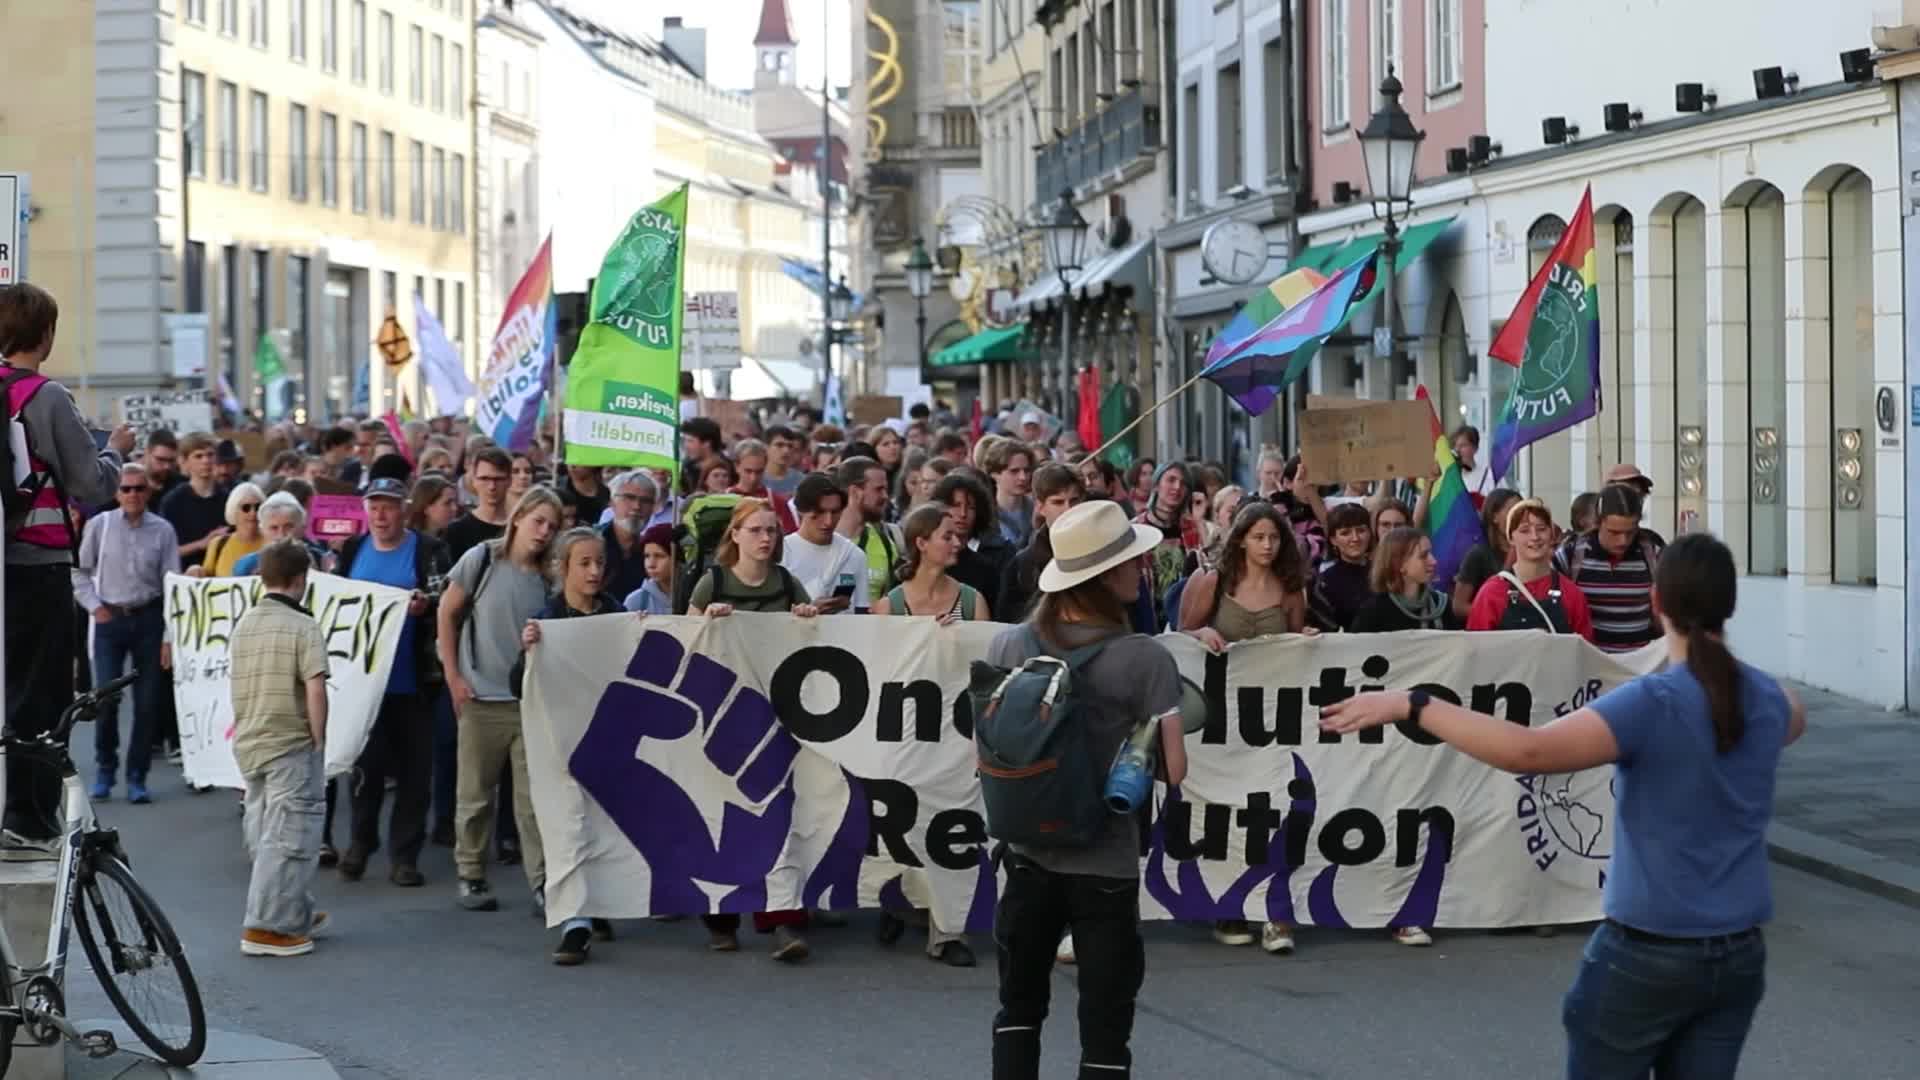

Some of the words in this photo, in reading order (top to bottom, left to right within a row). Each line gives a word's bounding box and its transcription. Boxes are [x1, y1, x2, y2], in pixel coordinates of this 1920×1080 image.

[1201, 652, 1532, 747] lution
[1554, 679, 1602, 717] FOR
[1516, 773, 1559, 871] FRIDA
